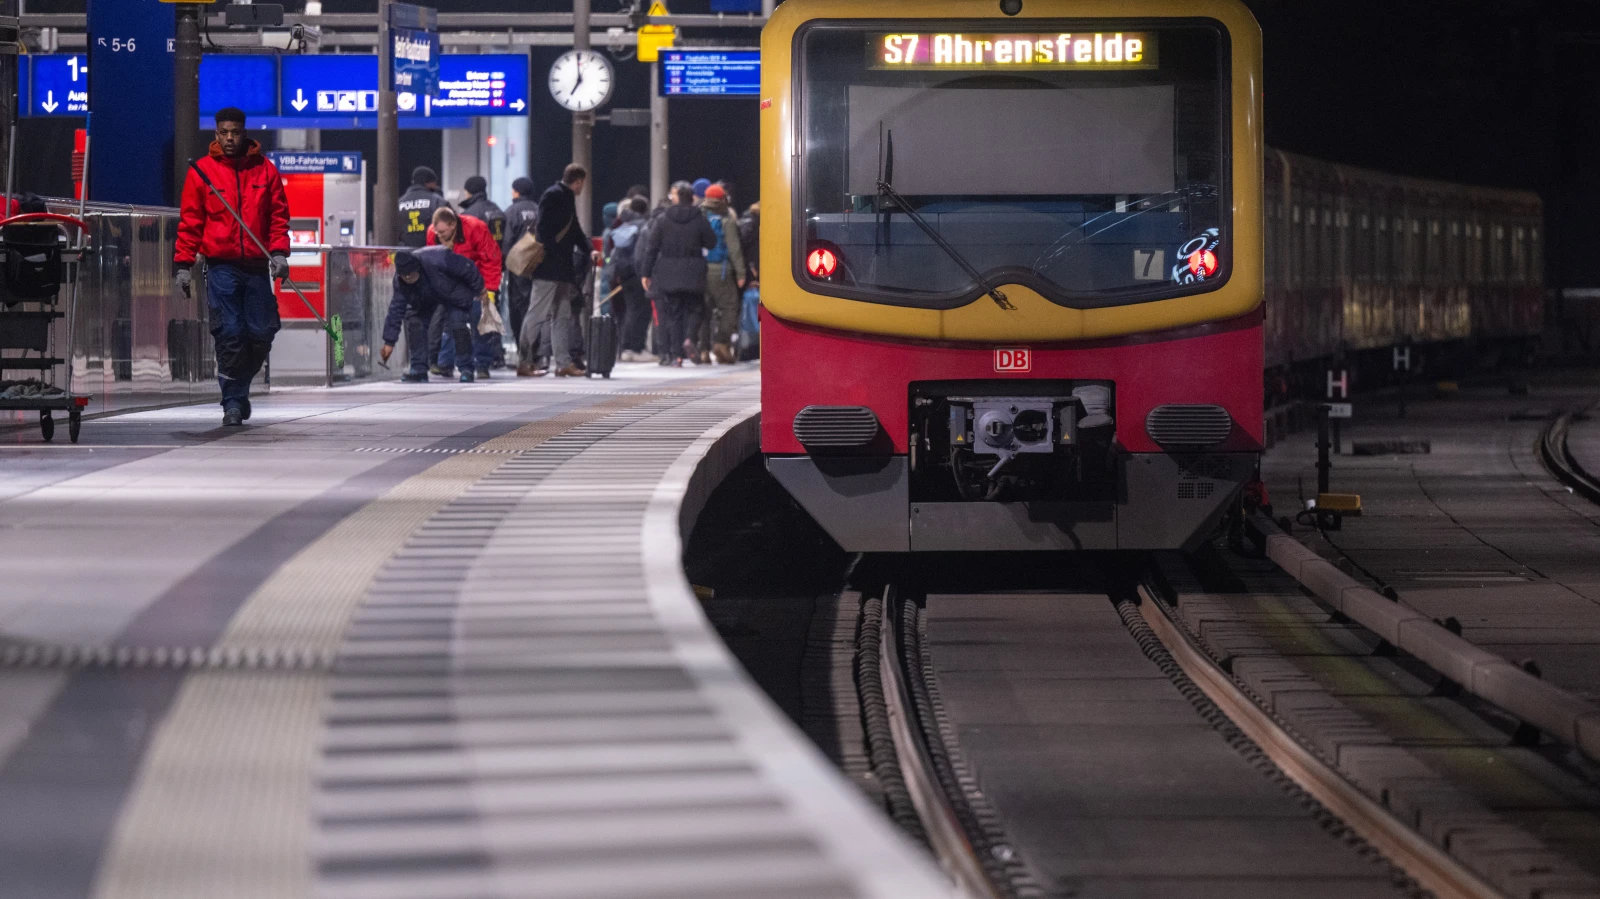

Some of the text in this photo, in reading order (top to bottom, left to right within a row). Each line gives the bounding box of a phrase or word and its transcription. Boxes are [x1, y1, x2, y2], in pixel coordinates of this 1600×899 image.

[112, 38, 136, 52] 5-6
[884, 32, 1143, 64] S7 Ahrensfelde
[279, 155, 339, 166] VBB-Fahrkarten
[399, 199, 431, 211] POLIZEI
[1139, 249, 1156, 277] 7
[998, 349, 1027, 368] DB
[1393, 346, 1410, 370] H
[1327, 369, 1347, 398] H
